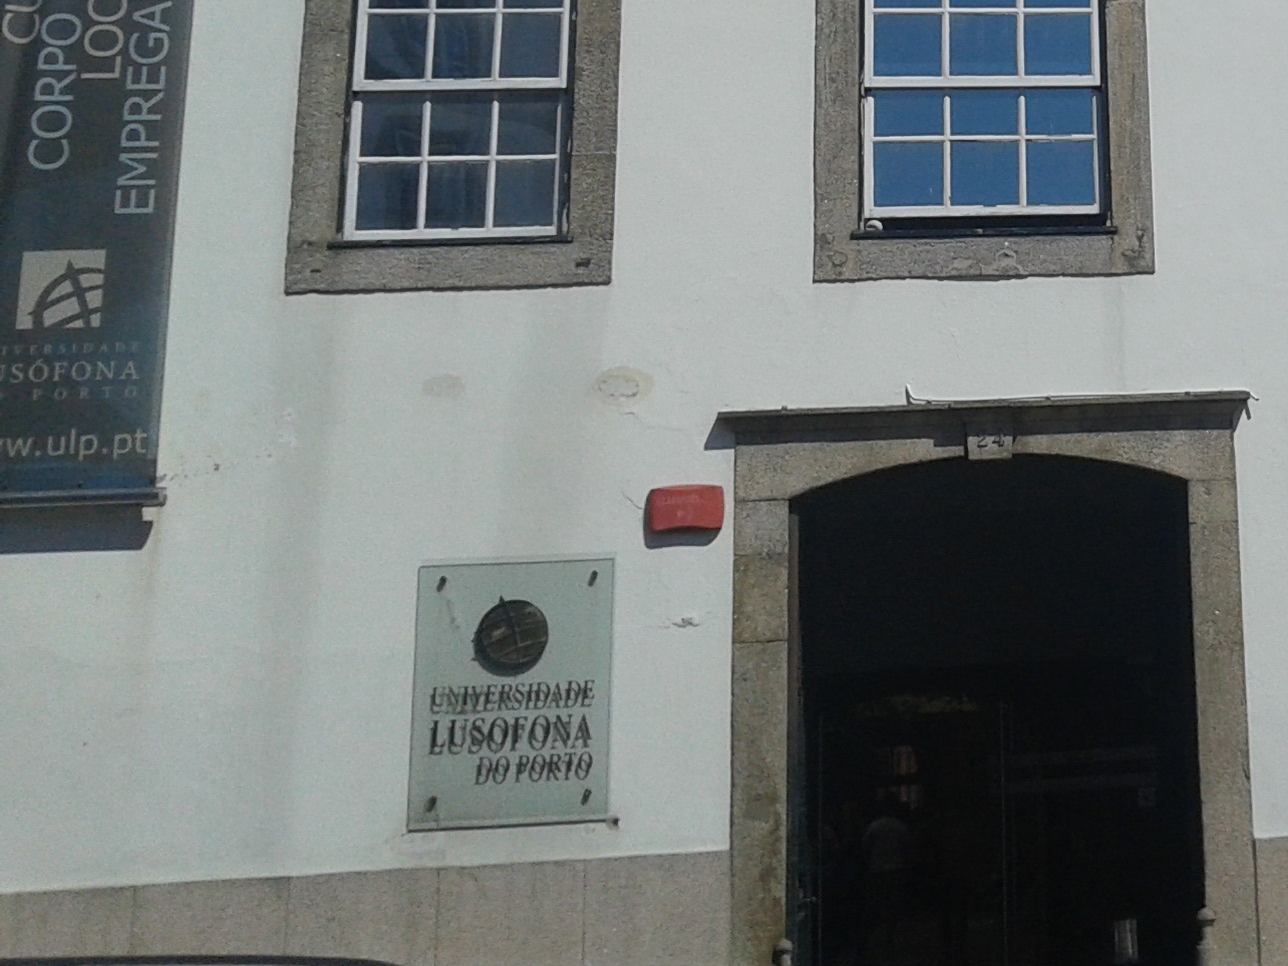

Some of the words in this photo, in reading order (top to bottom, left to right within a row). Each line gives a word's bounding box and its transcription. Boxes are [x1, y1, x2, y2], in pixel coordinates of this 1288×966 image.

[27, 13, 82, 170] CORPO
[31, 385, 138, 401] PORTO
[0, 428, 147, 461] w.ulp.pt
[430, 680, 595, 714] UNIVERSIDADE
[476, 755, 510, 784] DO
[516, 751, 593, 783] PORTO
